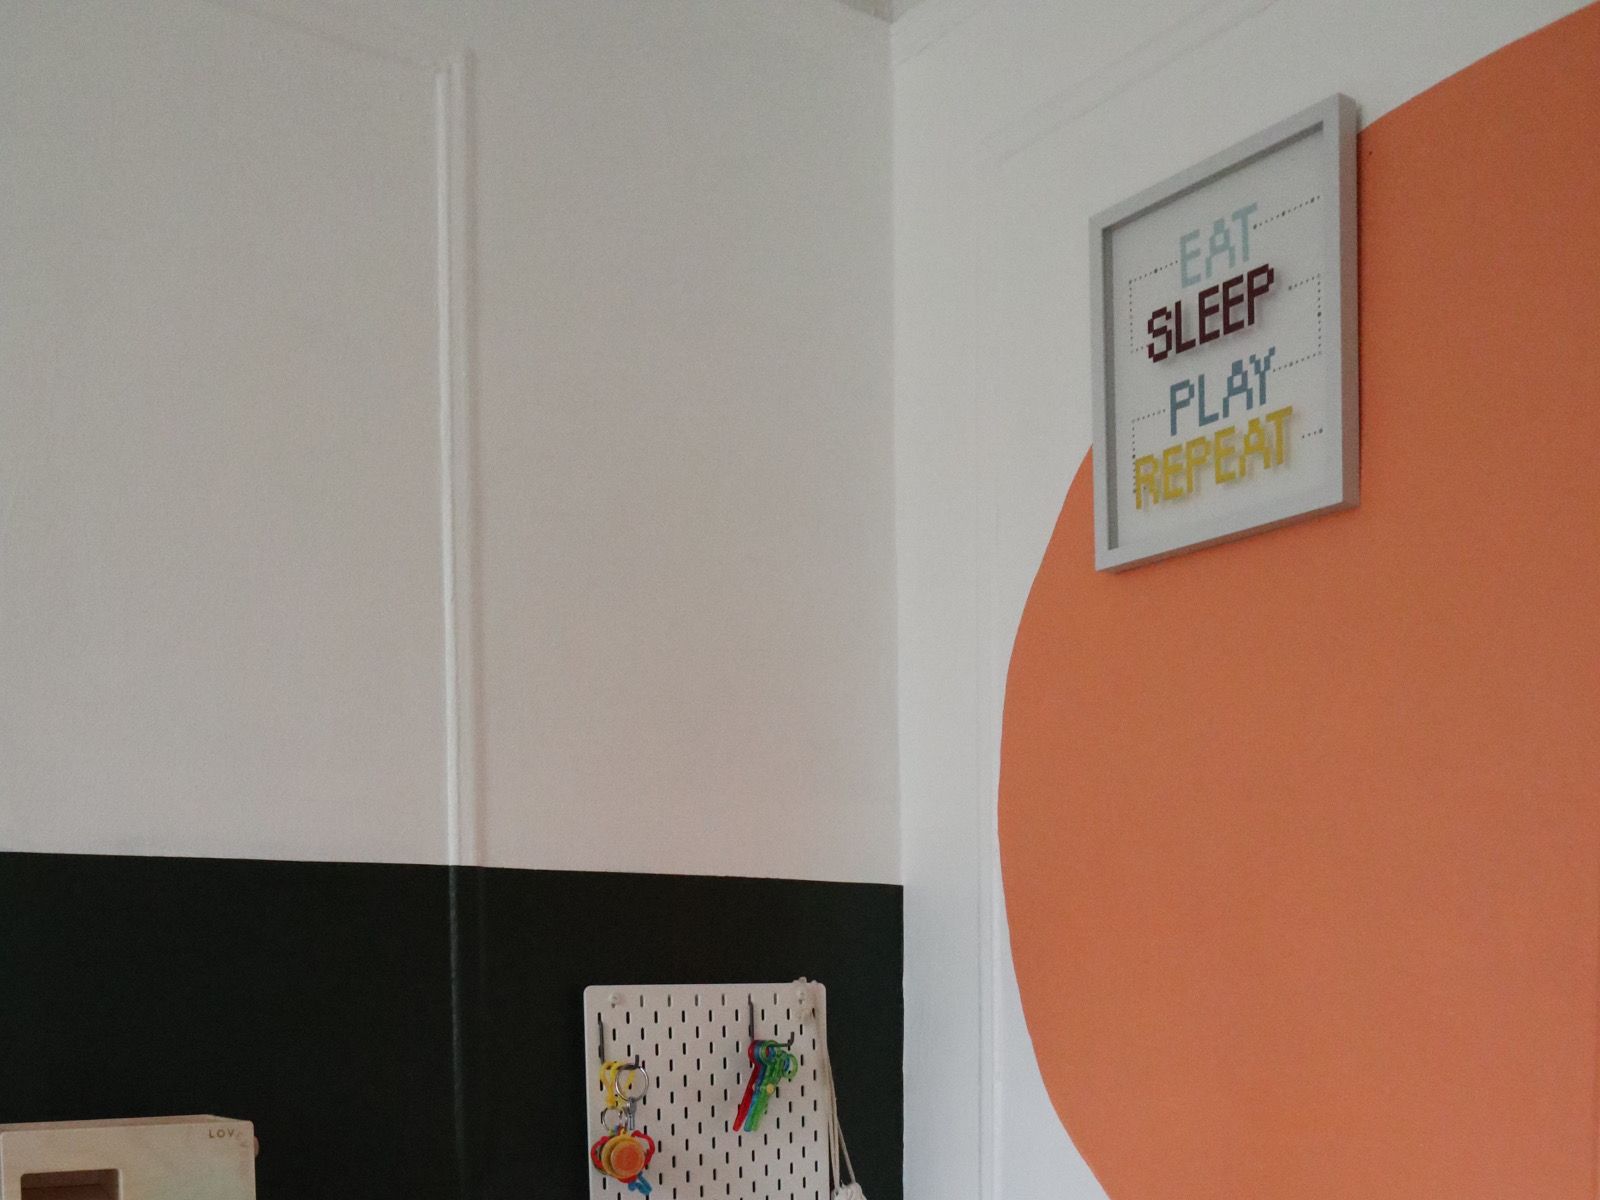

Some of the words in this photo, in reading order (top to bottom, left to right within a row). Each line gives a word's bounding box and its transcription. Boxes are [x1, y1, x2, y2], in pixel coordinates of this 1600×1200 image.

[1179, 201, 1258, 289] EAT
[1147, 263, 1275, 363] SLEEP
[1169, 346, 1276, 437] PLAY
[1134, 405, 1294, 511] REPEAT
